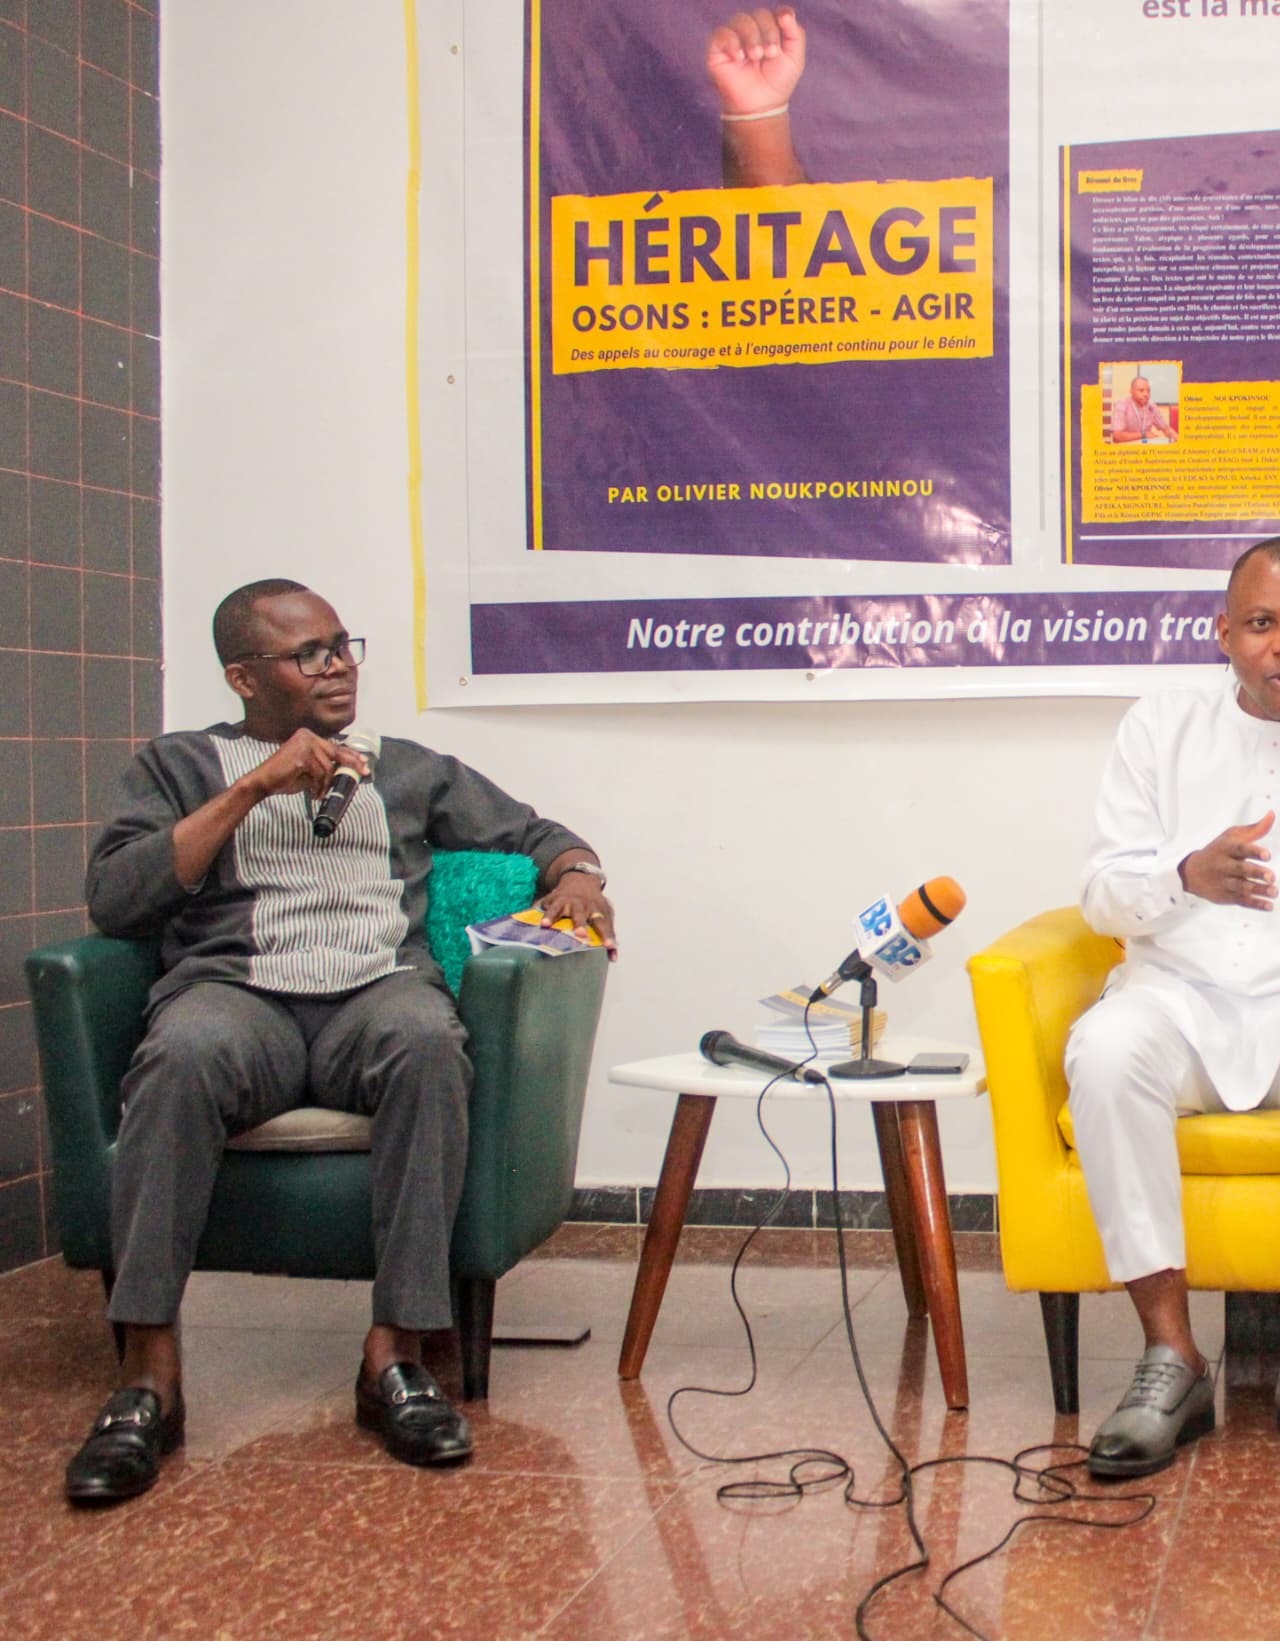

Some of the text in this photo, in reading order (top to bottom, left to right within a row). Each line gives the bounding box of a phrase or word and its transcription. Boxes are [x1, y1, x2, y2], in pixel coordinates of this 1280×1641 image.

[1143, 0, 1190, 18] est
[574, 193, 976, 287] HÉRITAGE
[573, 303, 689, 332] OSONS
[702, 311, 708, 328] :
[722, 289, 858, 327] ESPÉRER
[892, 293, 974, 320] AGIR
[571, 336, 975, 362] Des appels au courage et à l'engagement continu pour le Bénin
[609, 480, 934, 503] PAR OLIVIER NOUKPOKINNOU
[626, 618, 725, 648] Notre
[735, 612, 956, 648] contribution
[965, 611, 988, 644] à
[997, 608, 1031, 643] la
[1042, 610, 1148, 642] vision
